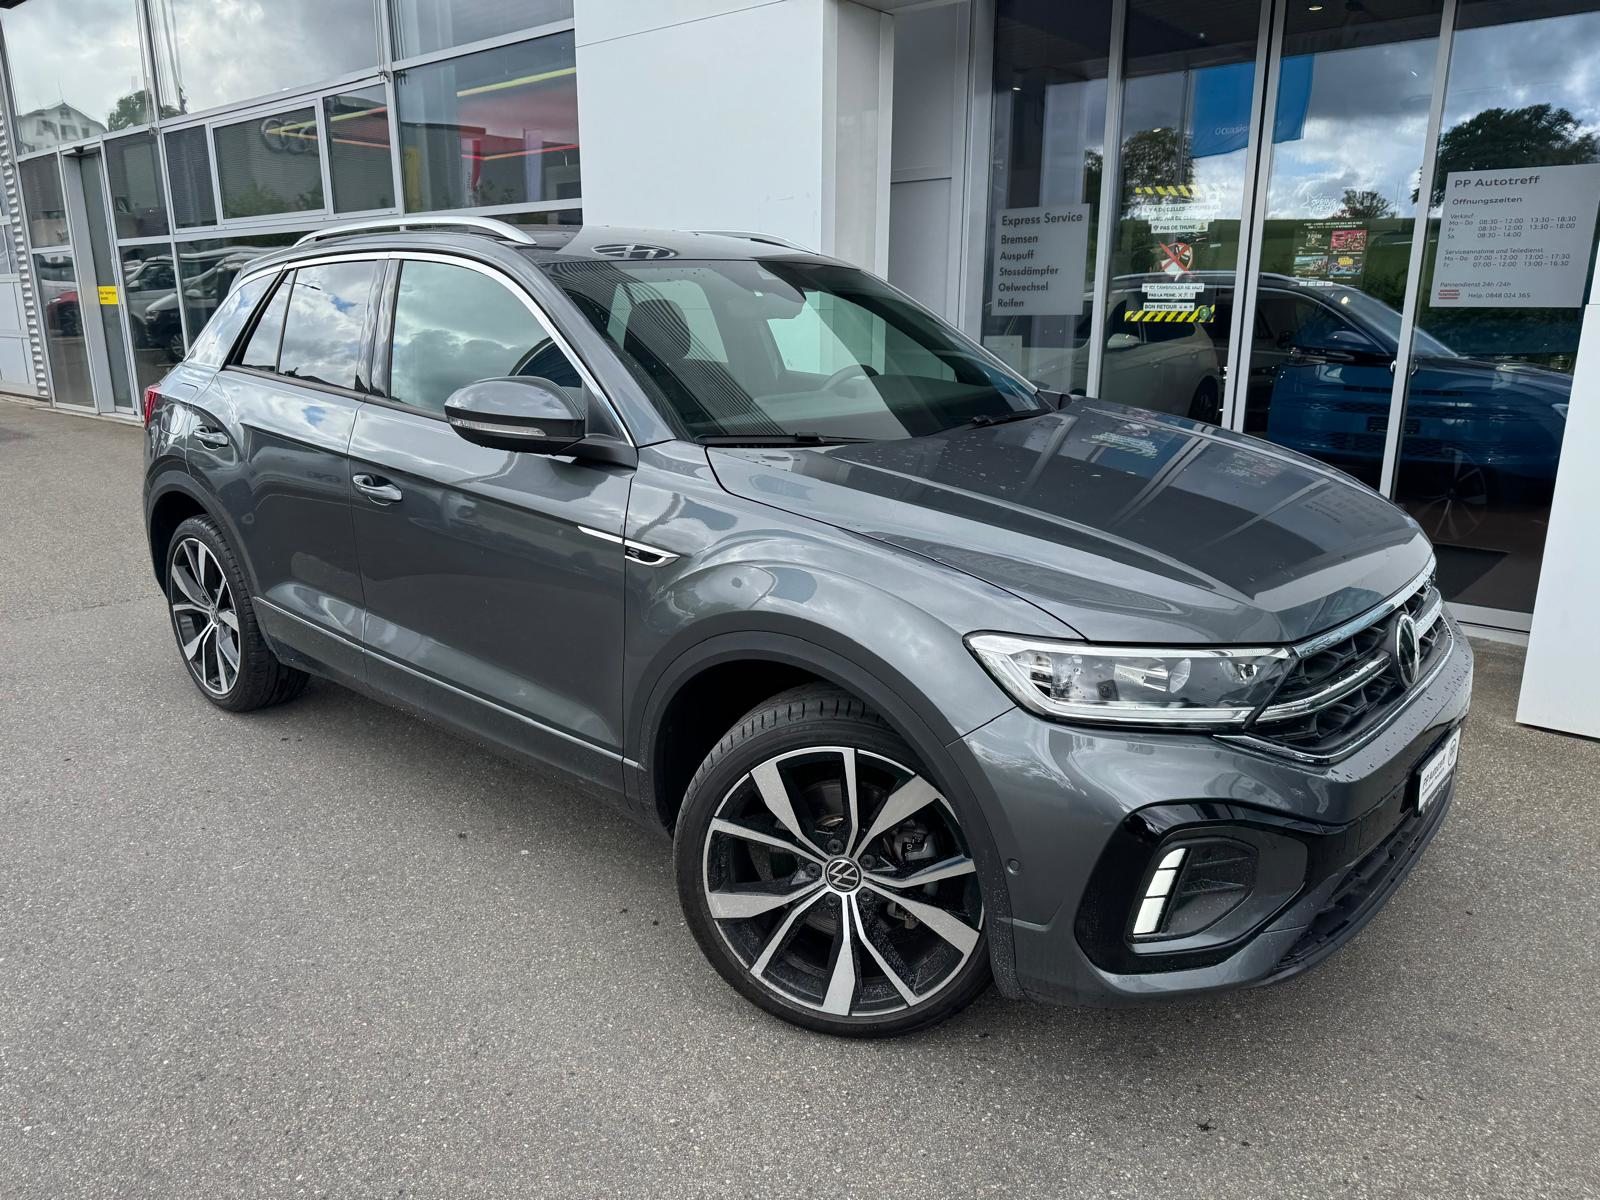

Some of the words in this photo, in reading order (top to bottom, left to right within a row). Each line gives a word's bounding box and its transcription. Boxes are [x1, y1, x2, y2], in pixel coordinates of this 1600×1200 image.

[1454, 179, 1471, 188] PP
[1474, 175, 1540, 187] Autotreff
[1001, 215, 1041, 228] Express
[1044, 211, 1083, 224] Service
[1001, 234, 1038, 245] Bremsen
[1000, 249, 1035, 261] Auspuff
[999, 265, 1059, 277] Stossdämpfer
[998, 281, 1049, 292] Oelwechsel
[997, 298, 1024, 308] Reifen
